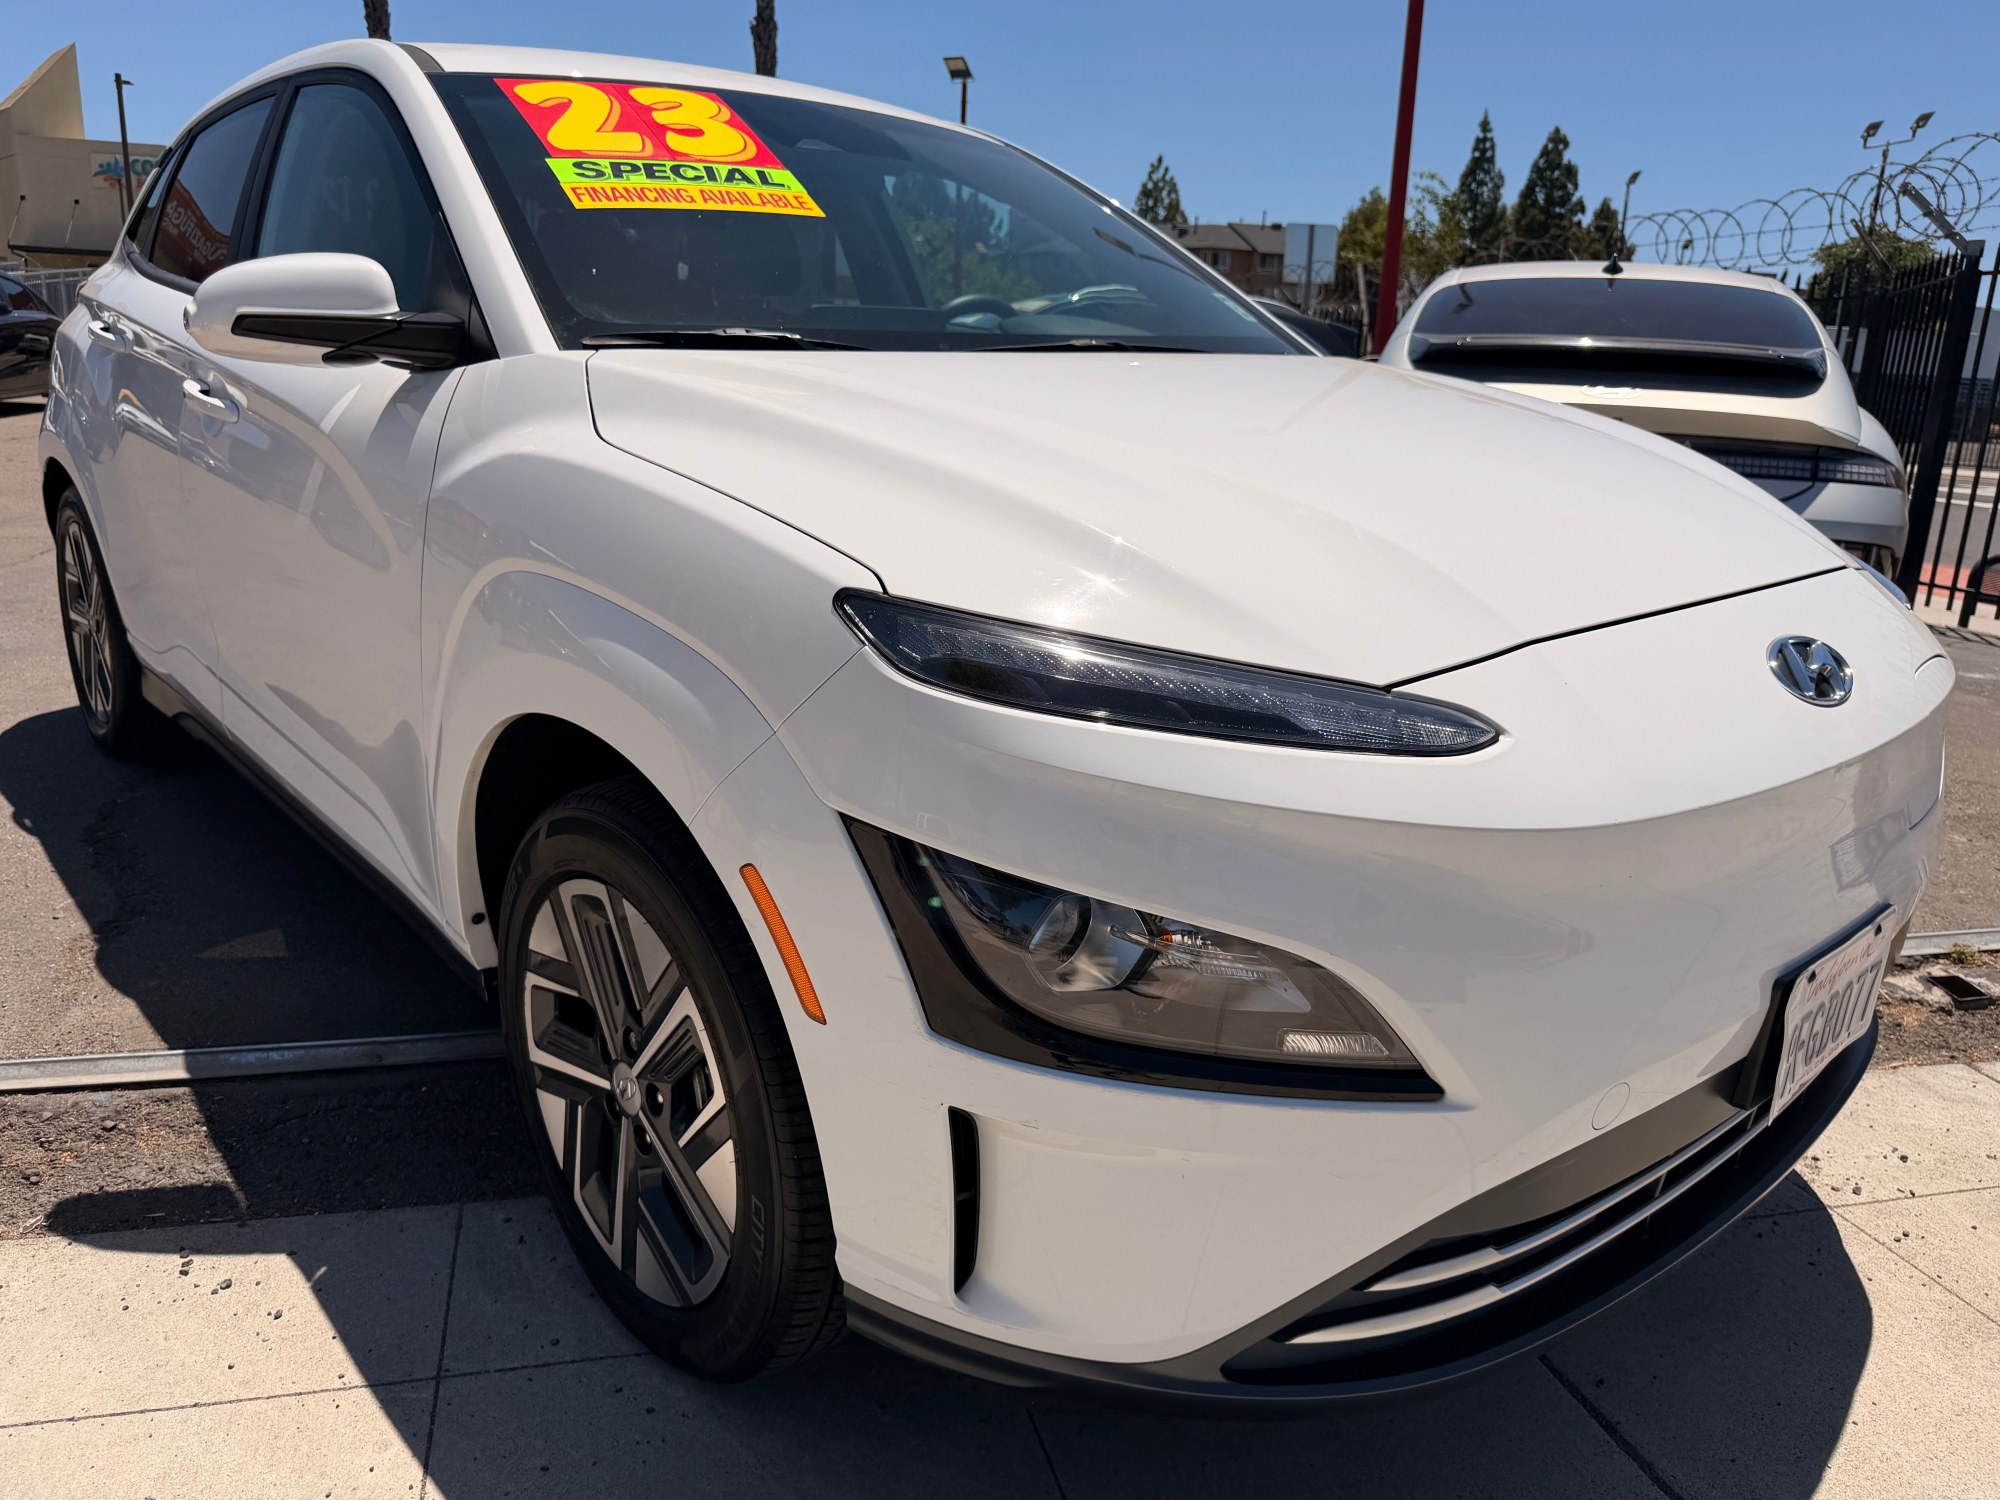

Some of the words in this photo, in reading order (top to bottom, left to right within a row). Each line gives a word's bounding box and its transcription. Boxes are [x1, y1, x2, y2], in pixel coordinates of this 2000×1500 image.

[513, 81, 757, 162] 23
[131, 158, 154, 175] CO
[572, 159, 791, 191] SPECIAL
[573, 186, 696, 206] FINANCING
[702, 189, 814, 212] AVAILABLE
[1806, 943, 1875, 1003] California
